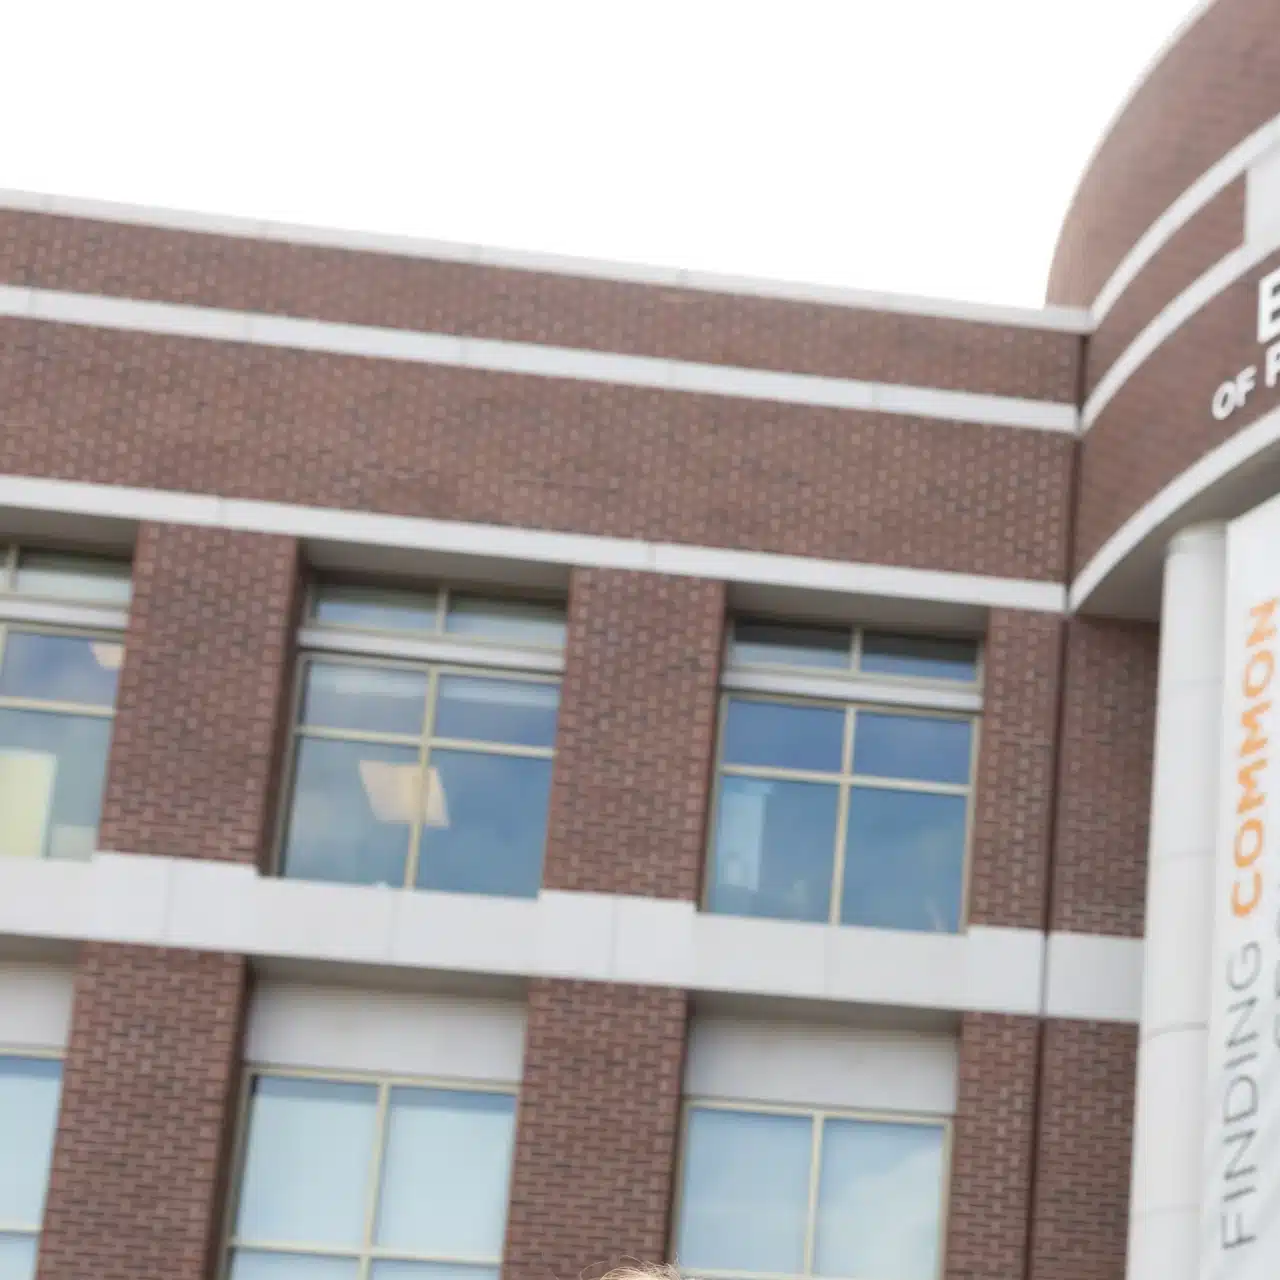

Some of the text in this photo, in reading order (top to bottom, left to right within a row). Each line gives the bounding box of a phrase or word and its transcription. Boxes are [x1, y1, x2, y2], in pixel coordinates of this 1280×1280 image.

[1211, 366, 1256, 420] OF
[1220, 597, 1280, 1250] FINDING COMMON
